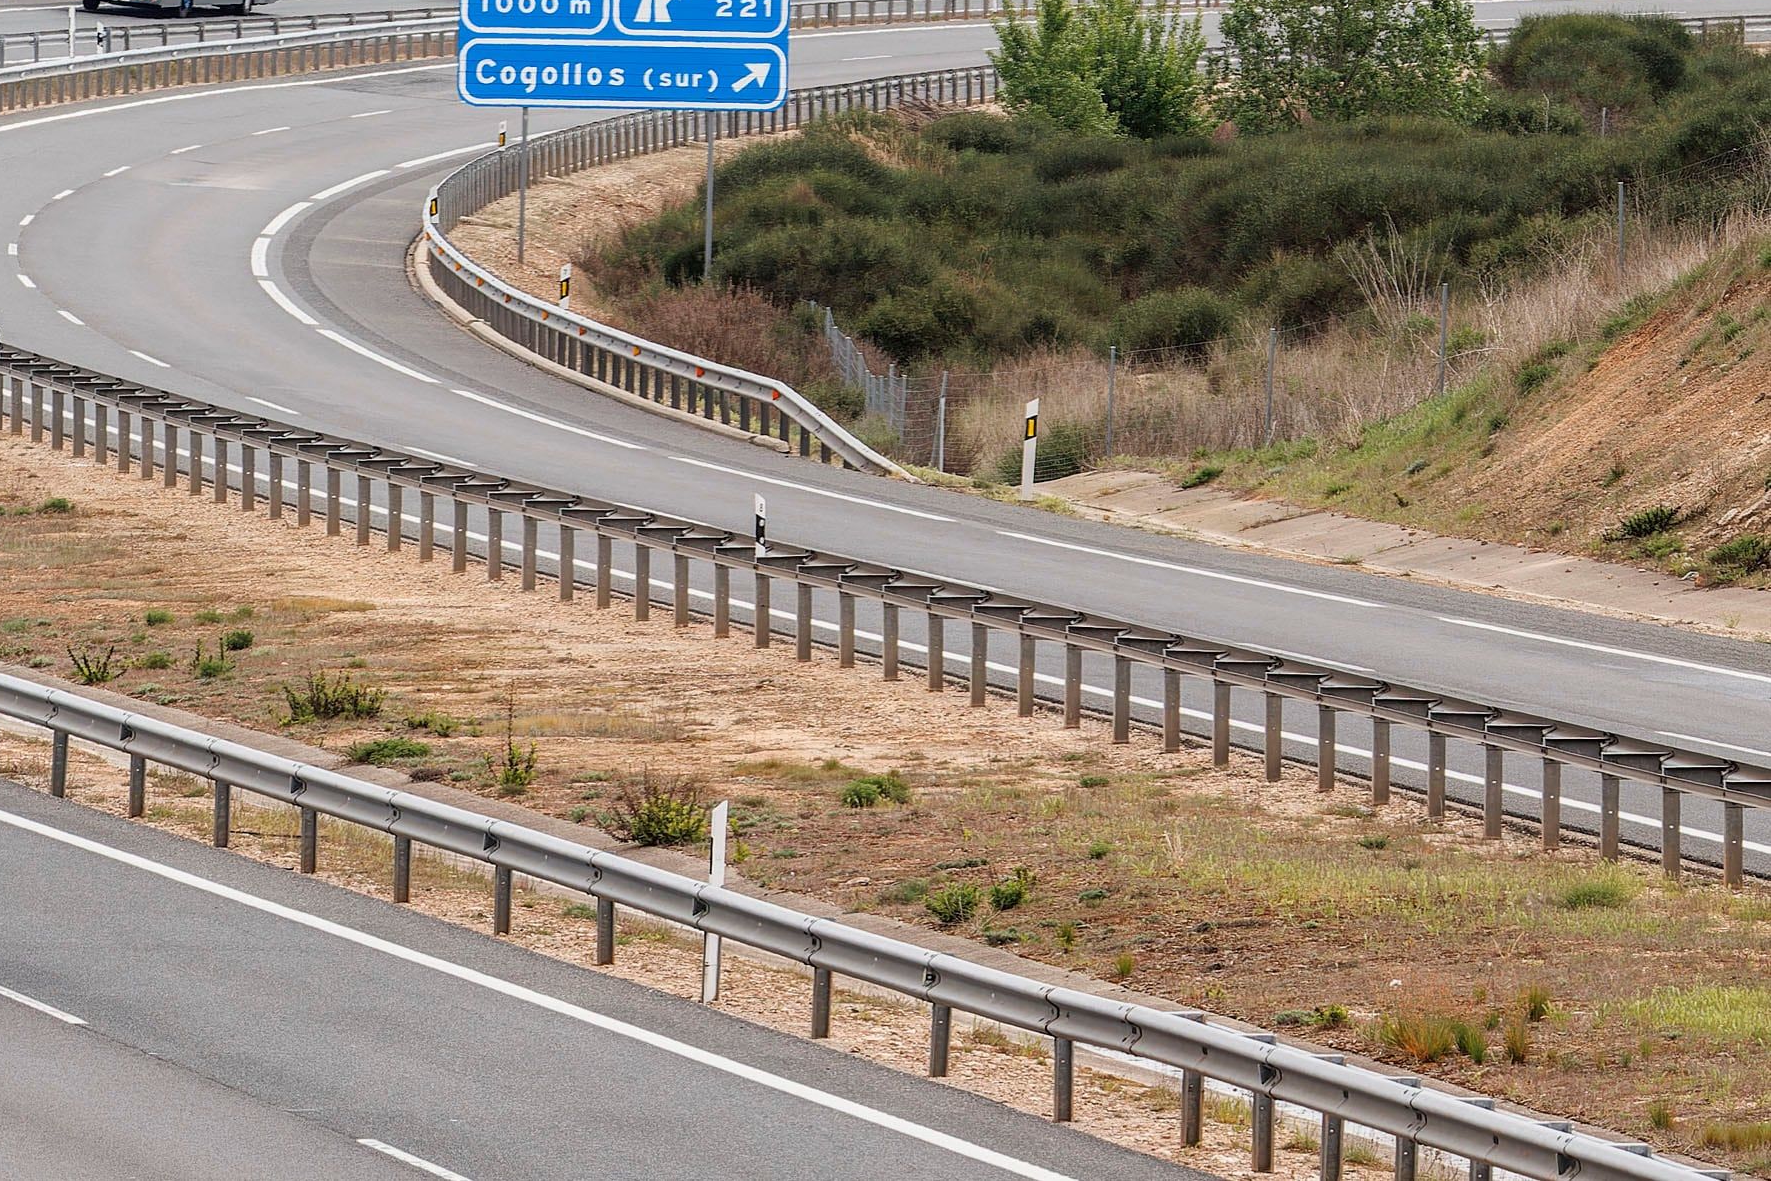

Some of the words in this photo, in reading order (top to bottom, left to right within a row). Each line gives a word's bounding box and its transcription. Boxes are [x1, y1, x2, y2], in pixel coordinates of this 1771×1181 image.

[569, 0, 591, 14] m
[475, 58, 625, 94] Cogollos
[643, 68, 718, 93] (sur)
